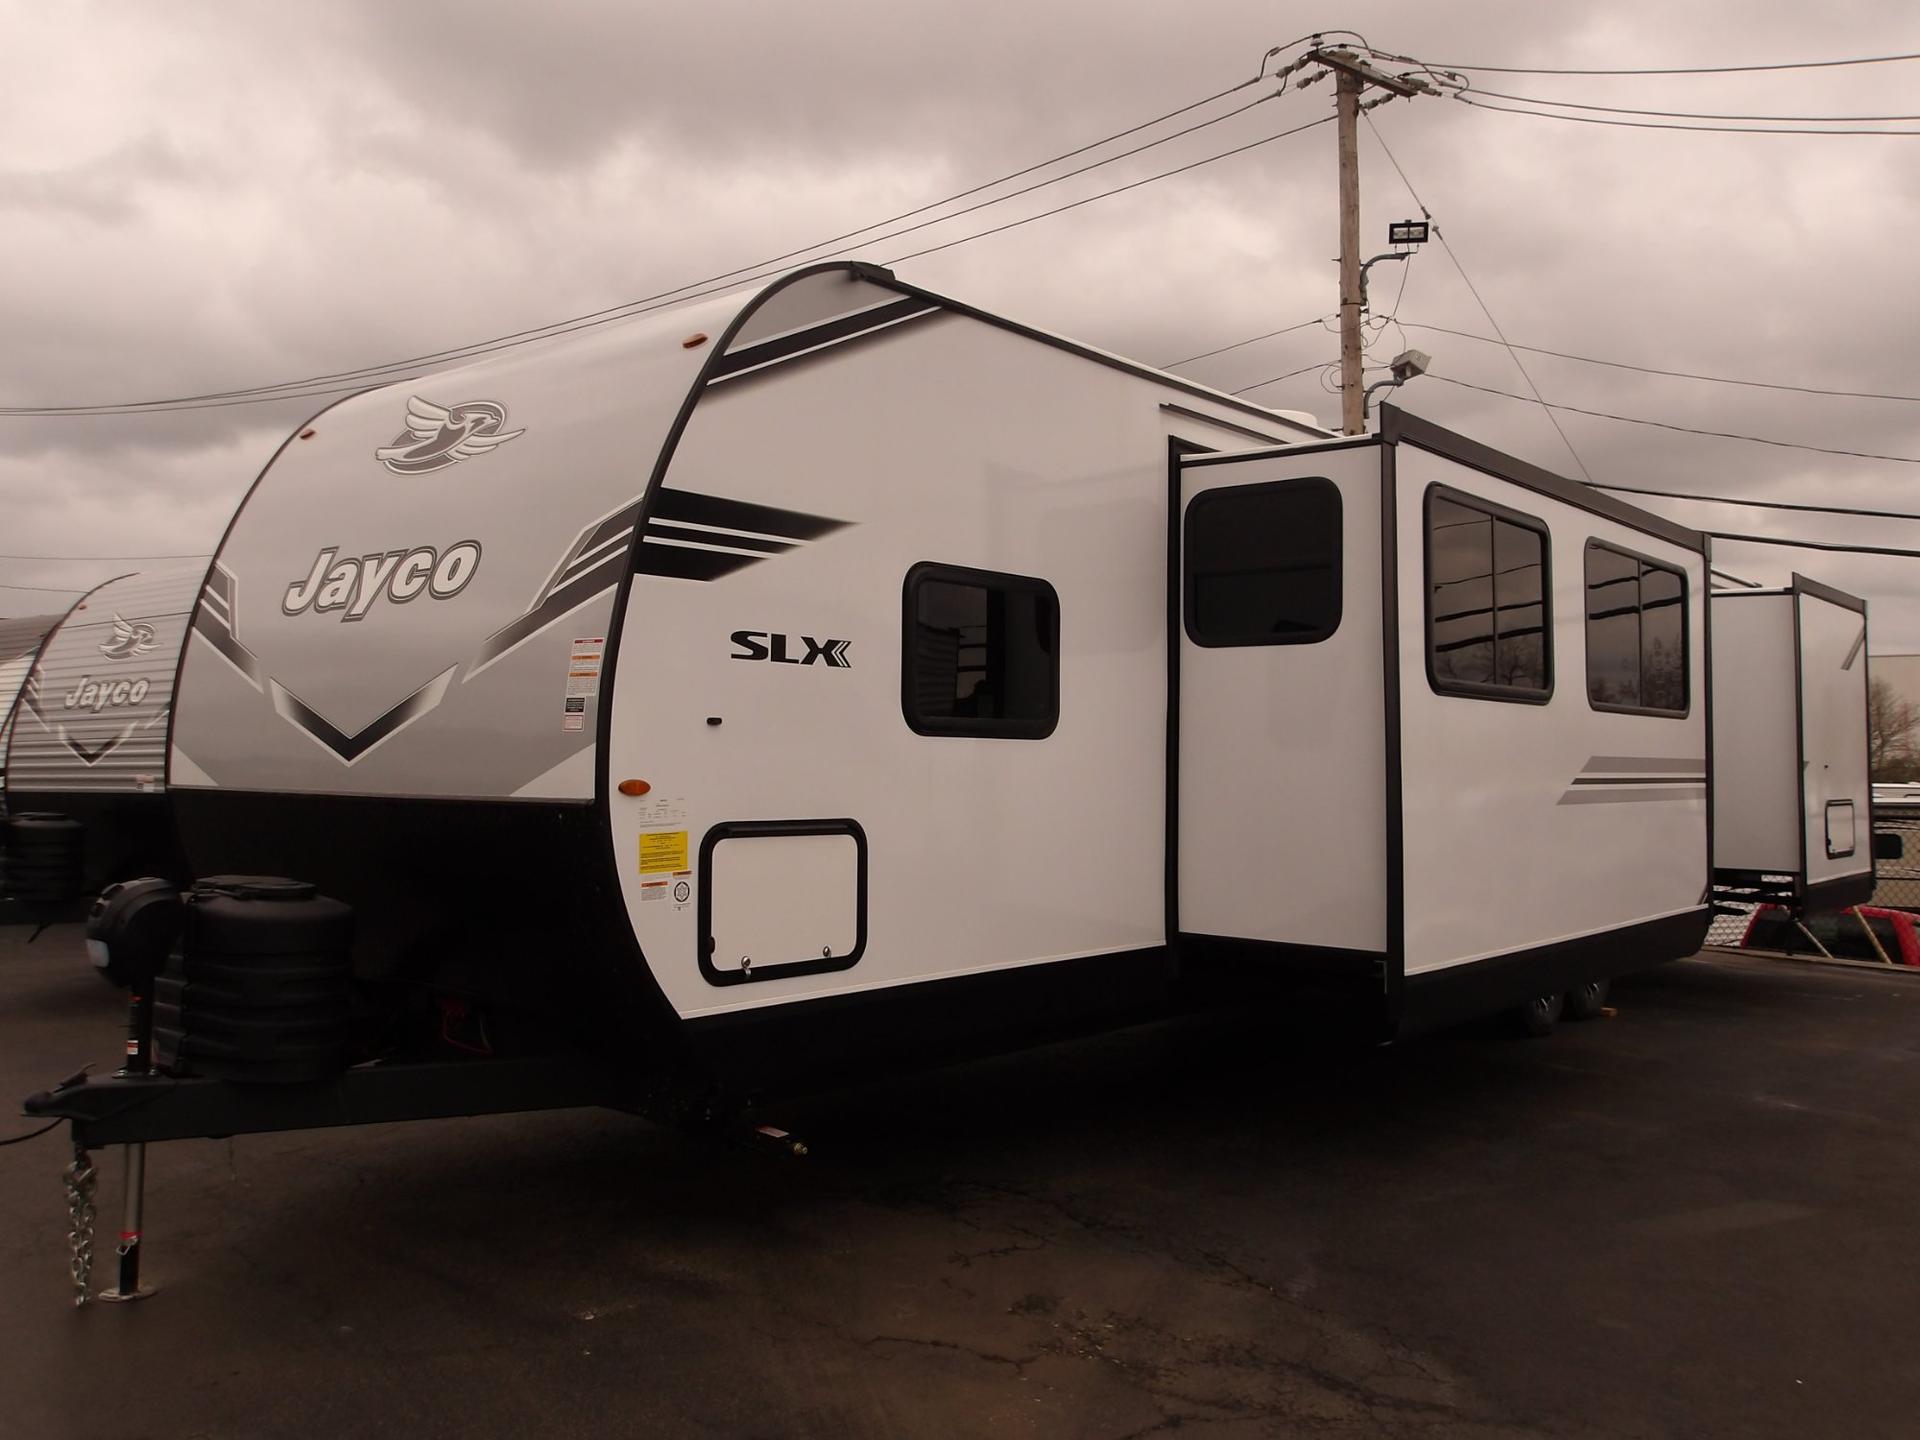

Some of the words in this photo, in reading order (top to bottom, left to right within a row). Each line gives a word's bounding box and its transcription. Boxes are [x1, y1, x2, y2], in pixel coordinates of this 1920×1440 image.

[282, 539, 482, 623] Jayco
[730, 630, 852, 668] SLX
[64, 675, 150, 714] Jayco
